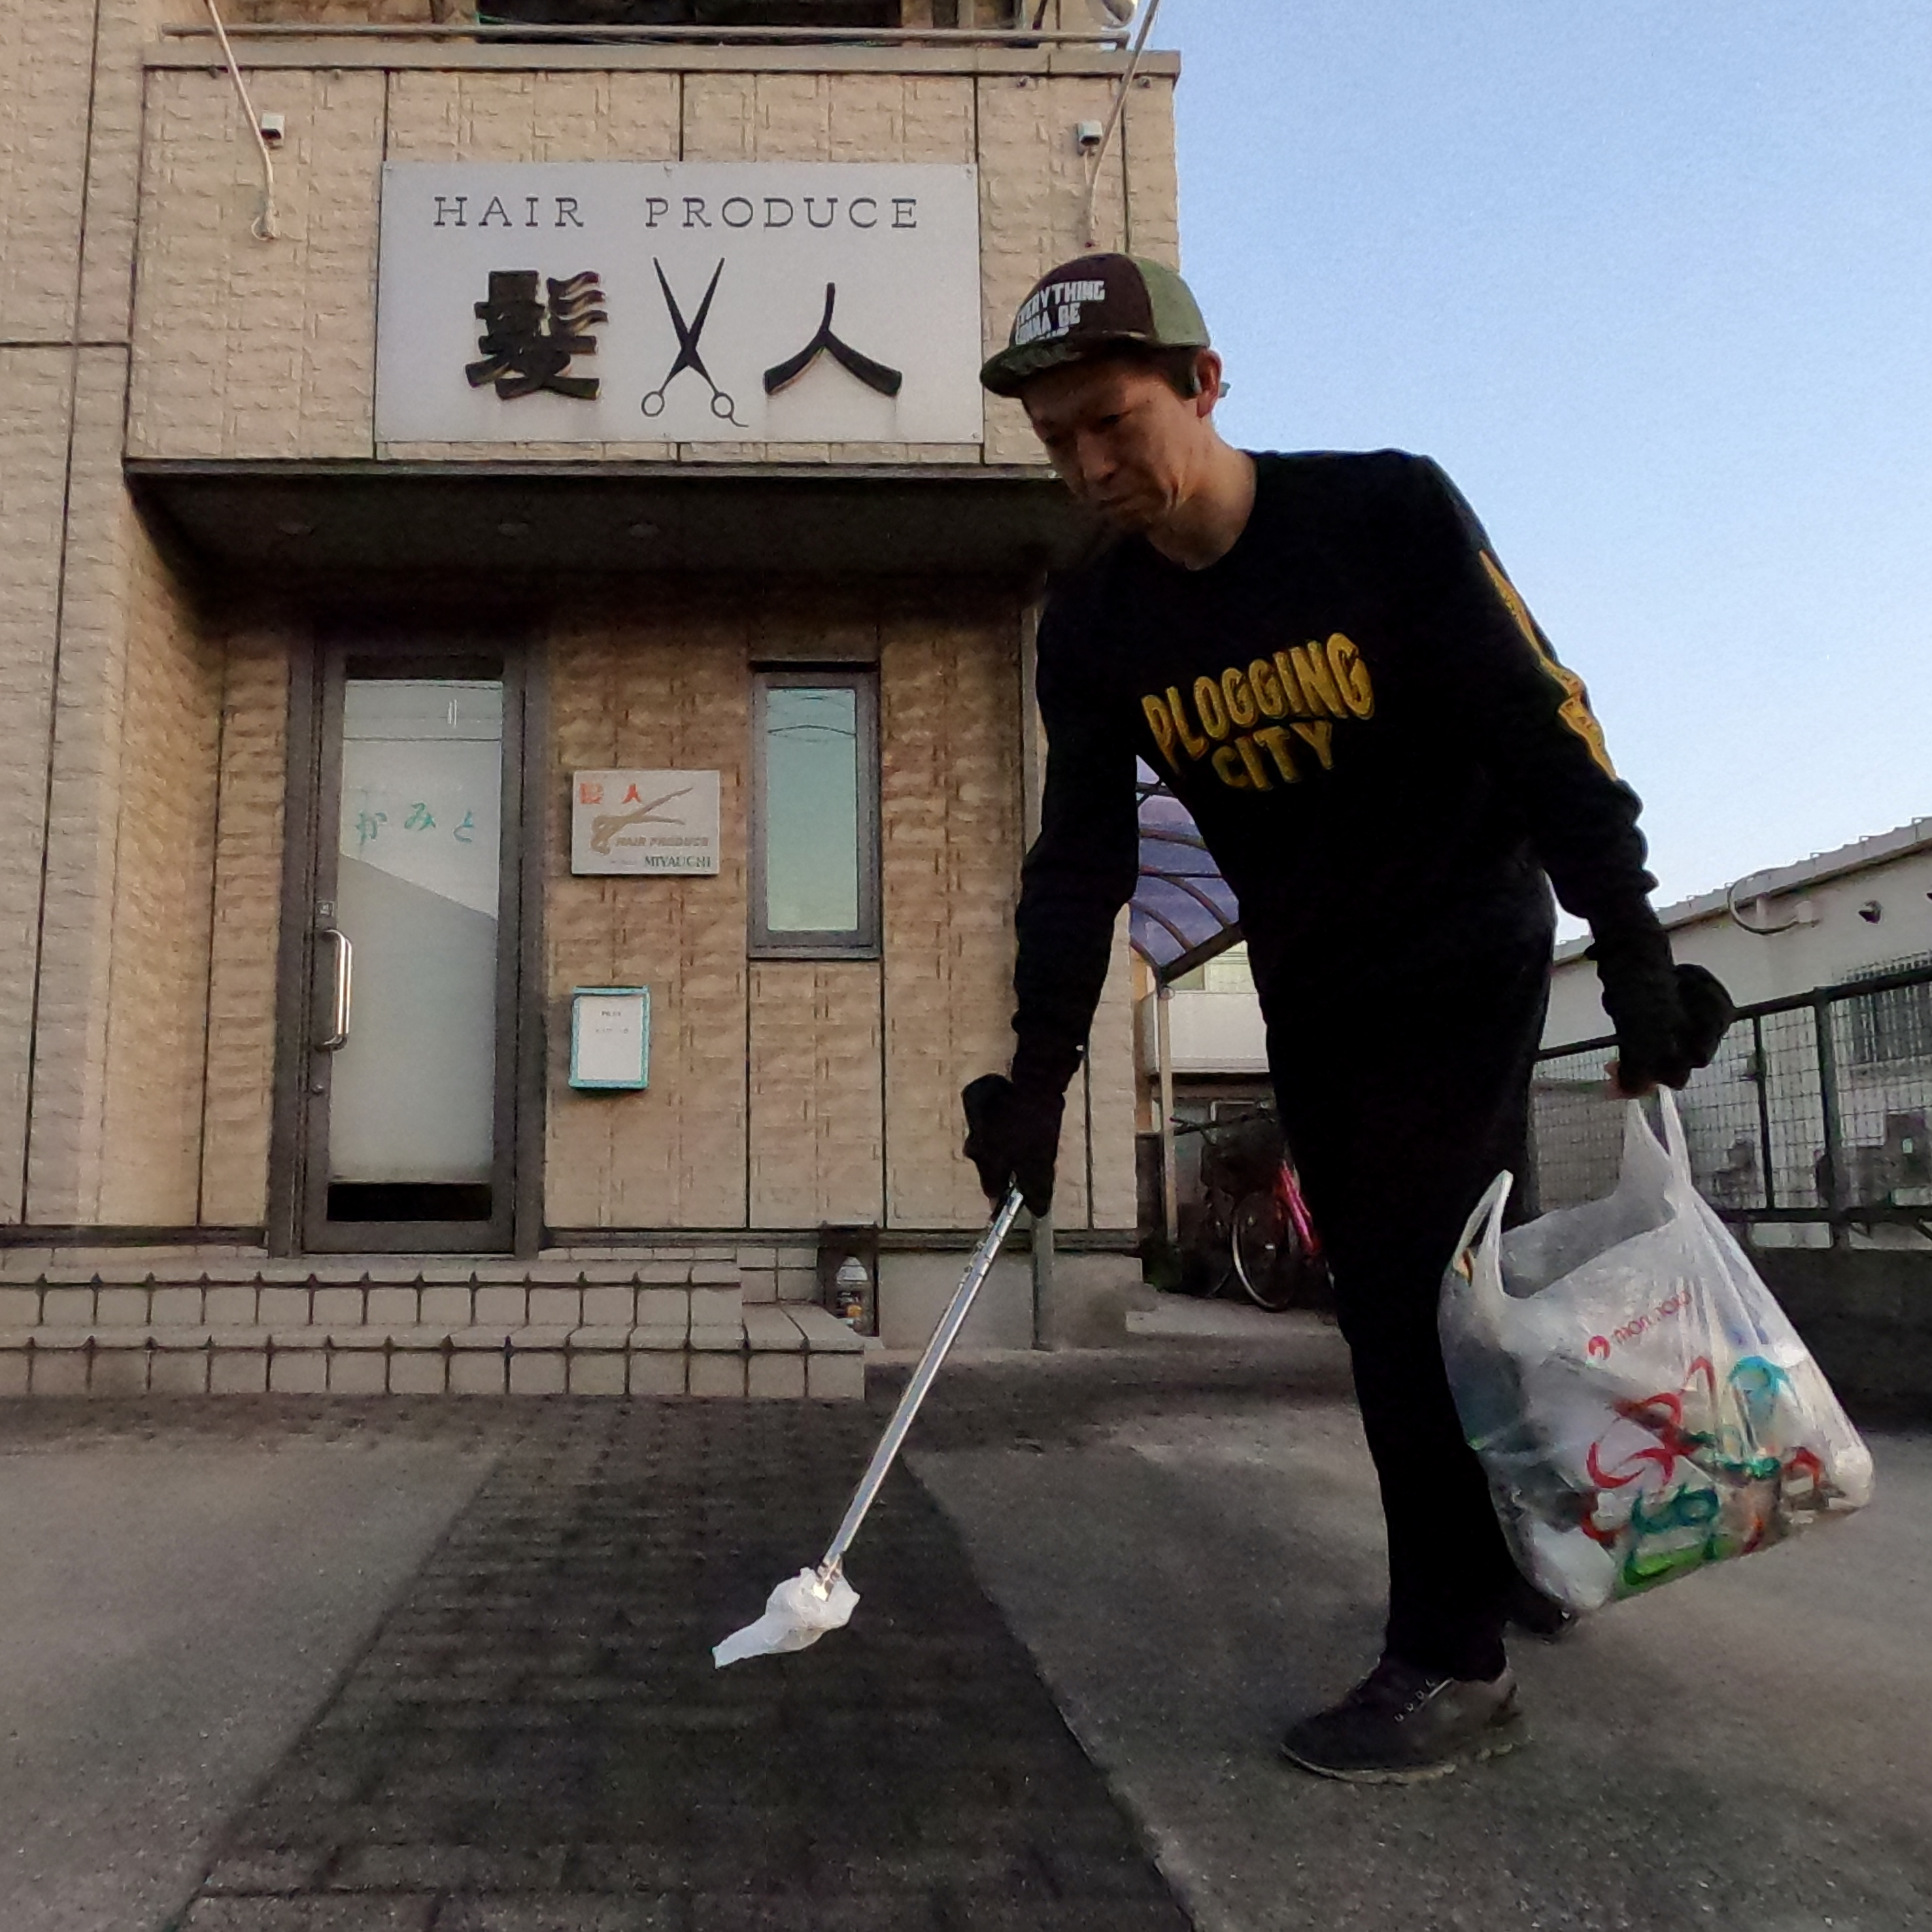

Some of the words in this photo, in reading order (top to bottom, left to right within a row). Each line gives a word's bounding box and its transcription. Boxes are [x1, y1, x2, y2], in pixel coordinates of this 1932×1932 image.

[433, 197, 585, 228] HAIR
[645, 197, 917, 229] PRODUCE
[465, 270, 609, 401] 髪
[764, 282, 903, 399] 人
[1141, 632, 1374, 773] PLOGGING
[1211, 720, 1333, 791] CITY
[645, 856, 711, 868] MIYAUCHI
